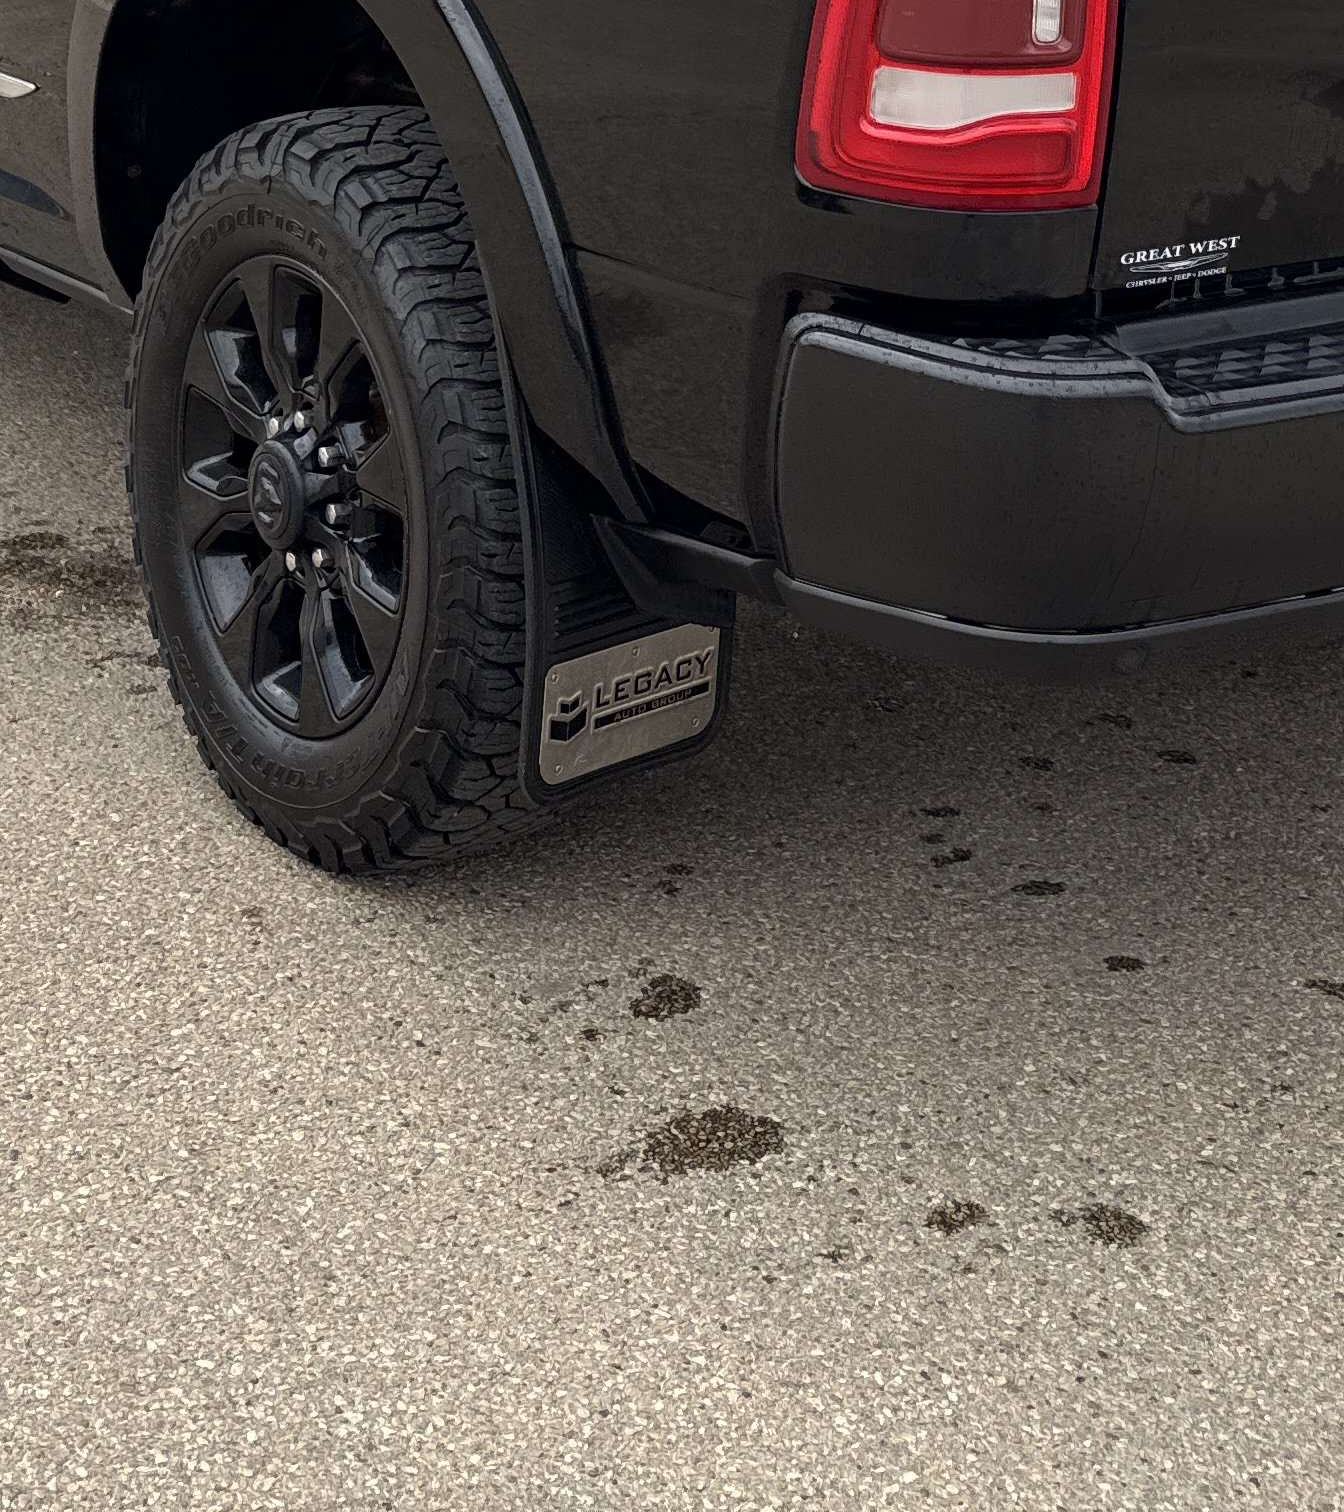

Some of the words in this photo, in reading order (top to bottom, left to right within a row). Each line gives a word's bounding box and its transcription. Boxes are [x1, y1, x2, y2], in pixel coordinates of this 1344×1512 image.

[1120, 244, 1185, 264] GREAT
[1189, 235, 1240, 254] WEST
[1197, 266, 1227, 278] DODGE
[594, 650, 712, 708] LEGACY
[613, 705, 647, 721] AUTO
[651, 689, 693, 709] GROUP
